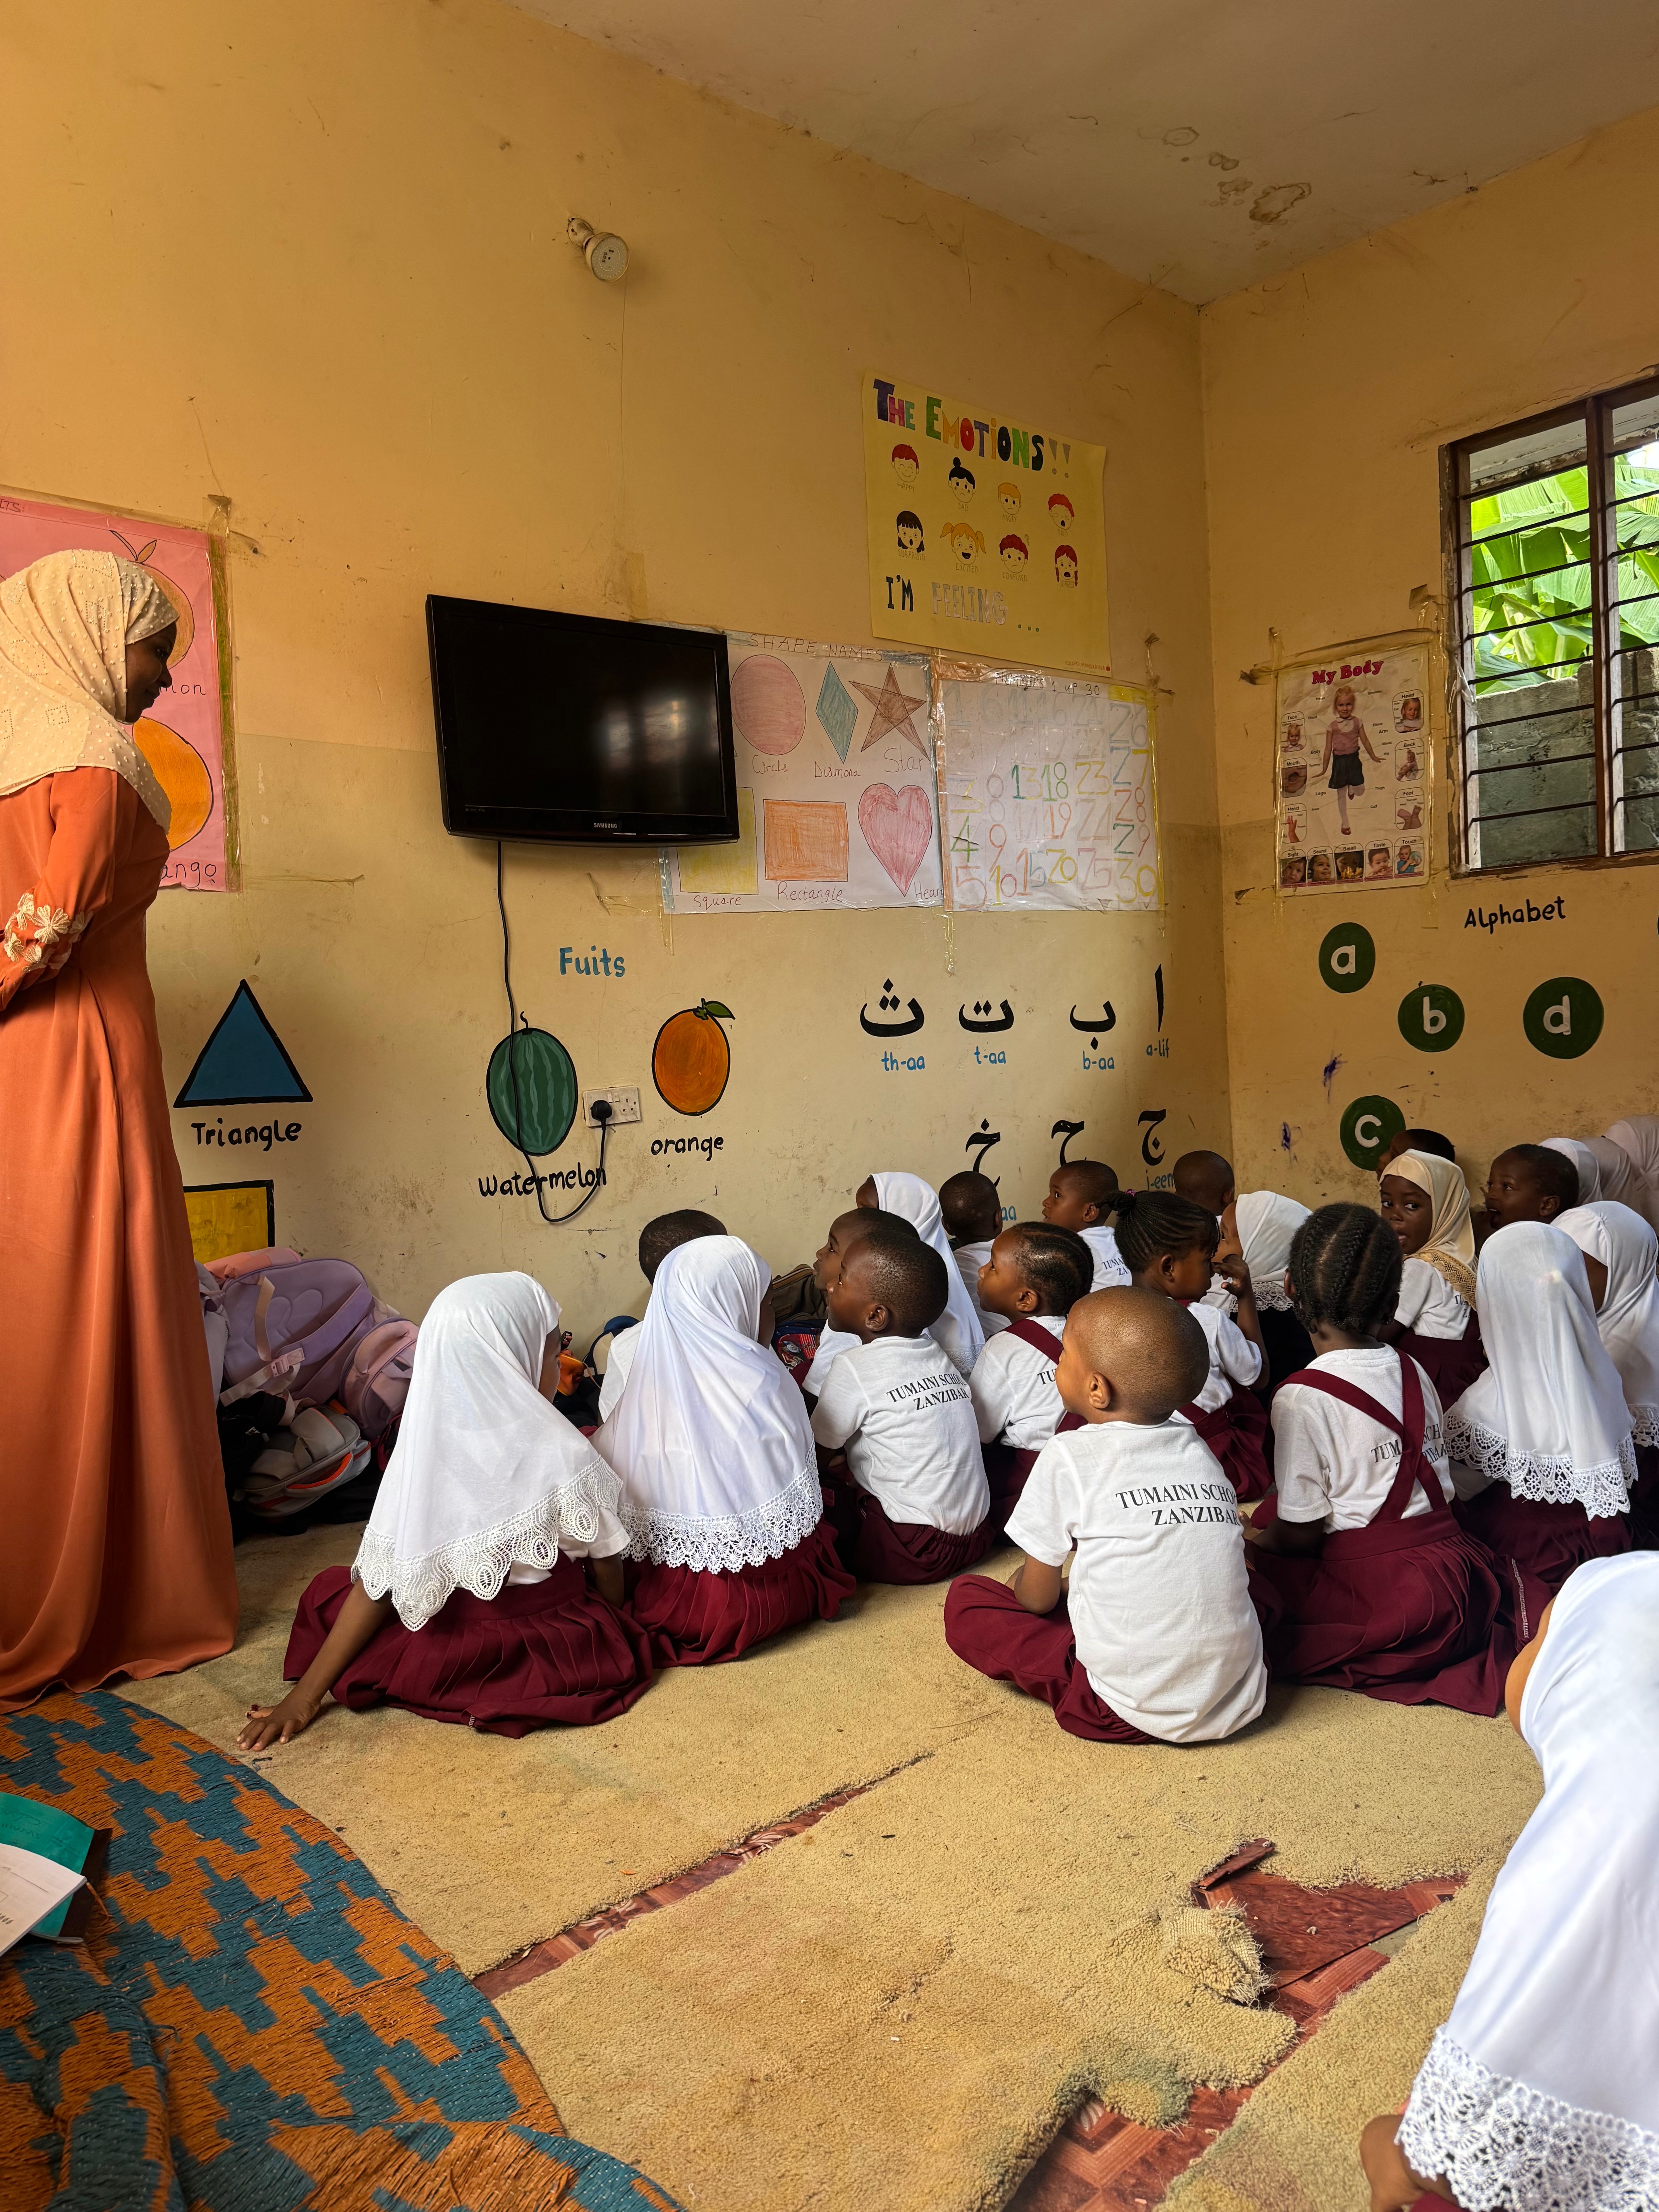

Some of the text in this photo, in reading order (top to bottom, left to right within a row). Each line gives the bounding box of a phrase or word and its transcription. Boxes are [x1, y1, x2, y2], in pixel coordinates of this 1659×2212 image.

[873, 378, 915, 430] THE
[897, 482, 915, 493] HAPPY
[958, 502, 969, 512] SAD
[1002, 514, 1017, 523] ANGRY
[898, 549, 926, 562] SURPRISED
[955, 563, 978, 573] EXCITED
[1002, 572, 1027, 582] CONFUSED
[886, 574, 914, 612] I'M
[931, 582, 1006, 625] FEELING
[748, 633, 883, 661] SHAPE NAMES
[1312, 659, 1384, 685] My Body
[1085, 684, 1100, 696] 30
[814, 760, 861, 779] Diamond
[884, 747, 924, 773] Star
[1011, 764, 1043, 800] 13
[1041, 762, 1069, 802] 18
[1075, 761, 1112, 795] 23
[1114, 787, 1146, 823] 28
[950, 815, 980, 863] 4
[989, 824, 1007, 873] 9
[1043, 801, 1072, 840] 19
[1113, 823, 1150, 857] 29
[914, 880, 944, 900] Heart
[955, 847, 1158, 908] 5 10 15 20 25 30
[692, 895, 742, 910] Square
[777, 881, 844, 903] Rectangle
[1464, 895, 1566, 934] Alphabet
[559, 945, 626, 977] Fuits
[1331, 945, 1356, 975] a
[859, 978, 925, 1037] ث
[958, 998, 1015, 1033] ت
[1423, 995, 1447, 1034] b
[1543, 994, 1572, 1036] d
[1069, 1000, 1116, 1051] ب
[974, 1046, 1006, 1065] t-aa
[1082, 1050, 1115, 1071] b-aa
[1146, 1037, 1170, 1058] a-lif
[881, 1051, 926, 1072] th-aa
[191, 1117, 302, 1152] Triangle
[1137, 1109, 1166, 1166] ج
[1354, 1114, 1382, 1148] c
[651, 1134, 724, 1161] orange
[478, 1161, 607, 1198] Watermelon
[886, 1374, 939, 1403] TUMAINI
[913, 1388, 969, 1411] ZANZIBAR
[1115, 1484, 1200, 1509] TUMAINI
[1151, 1506, 1241, 1526] ZANZIBAR
